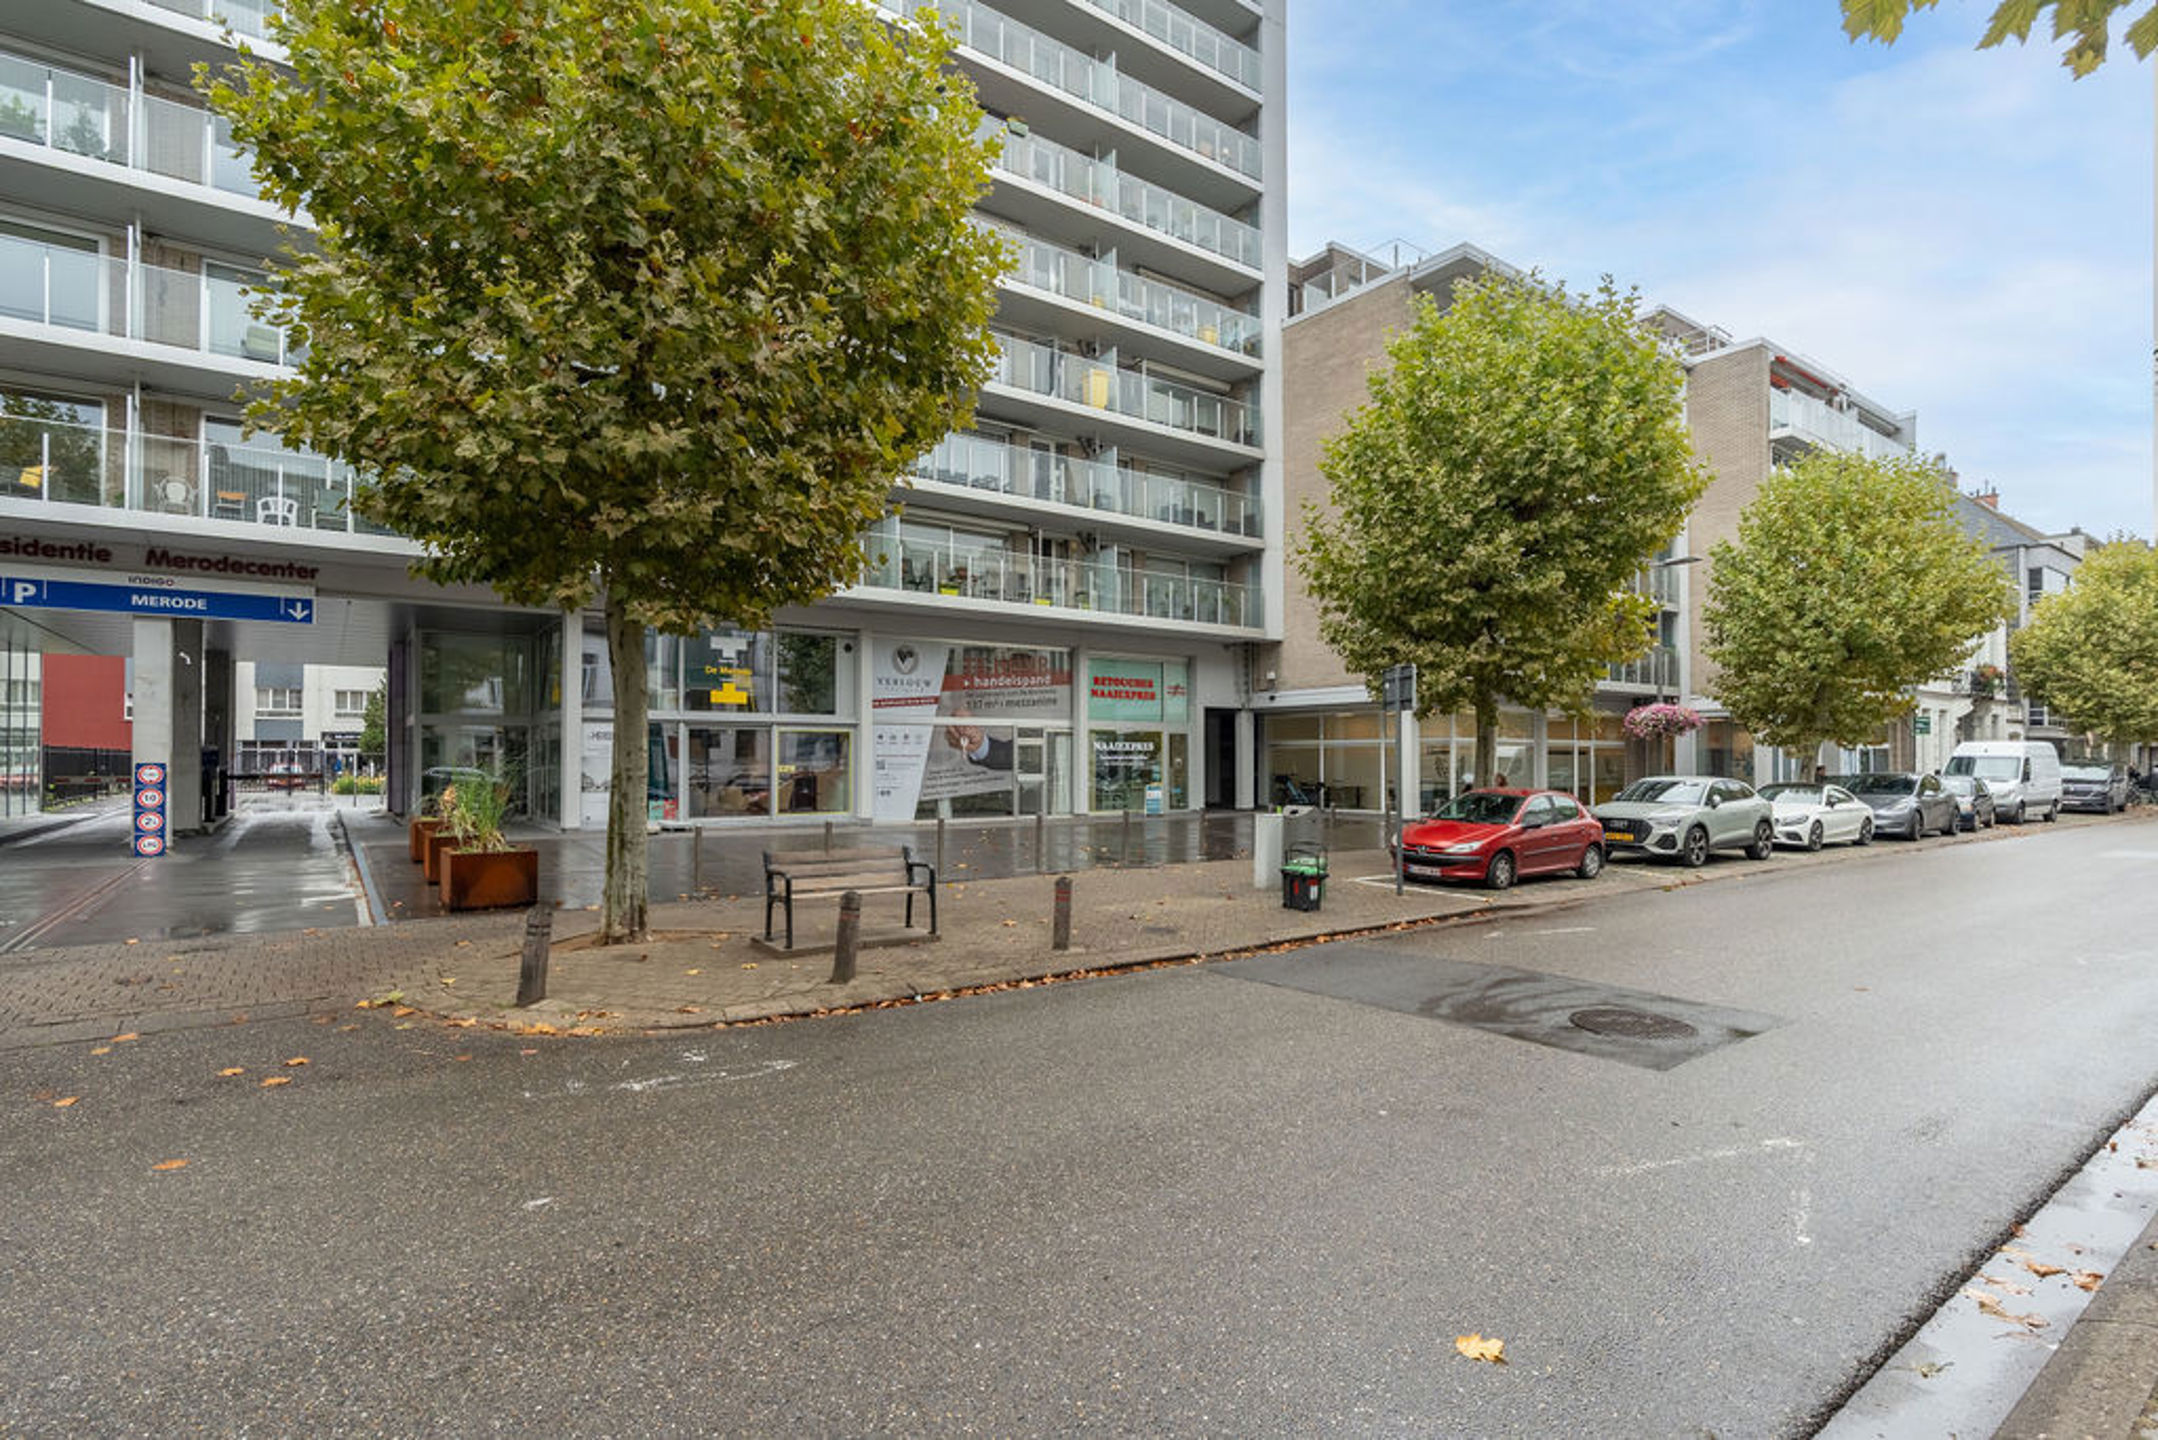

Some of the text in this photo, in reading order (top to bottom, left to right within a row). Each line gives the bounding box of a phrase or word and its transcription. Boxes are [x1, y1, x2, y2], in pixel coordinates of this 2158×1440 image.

[144, 548, 320, 580] Merodecenter
[13, 581, 208, 611] P MERODE
